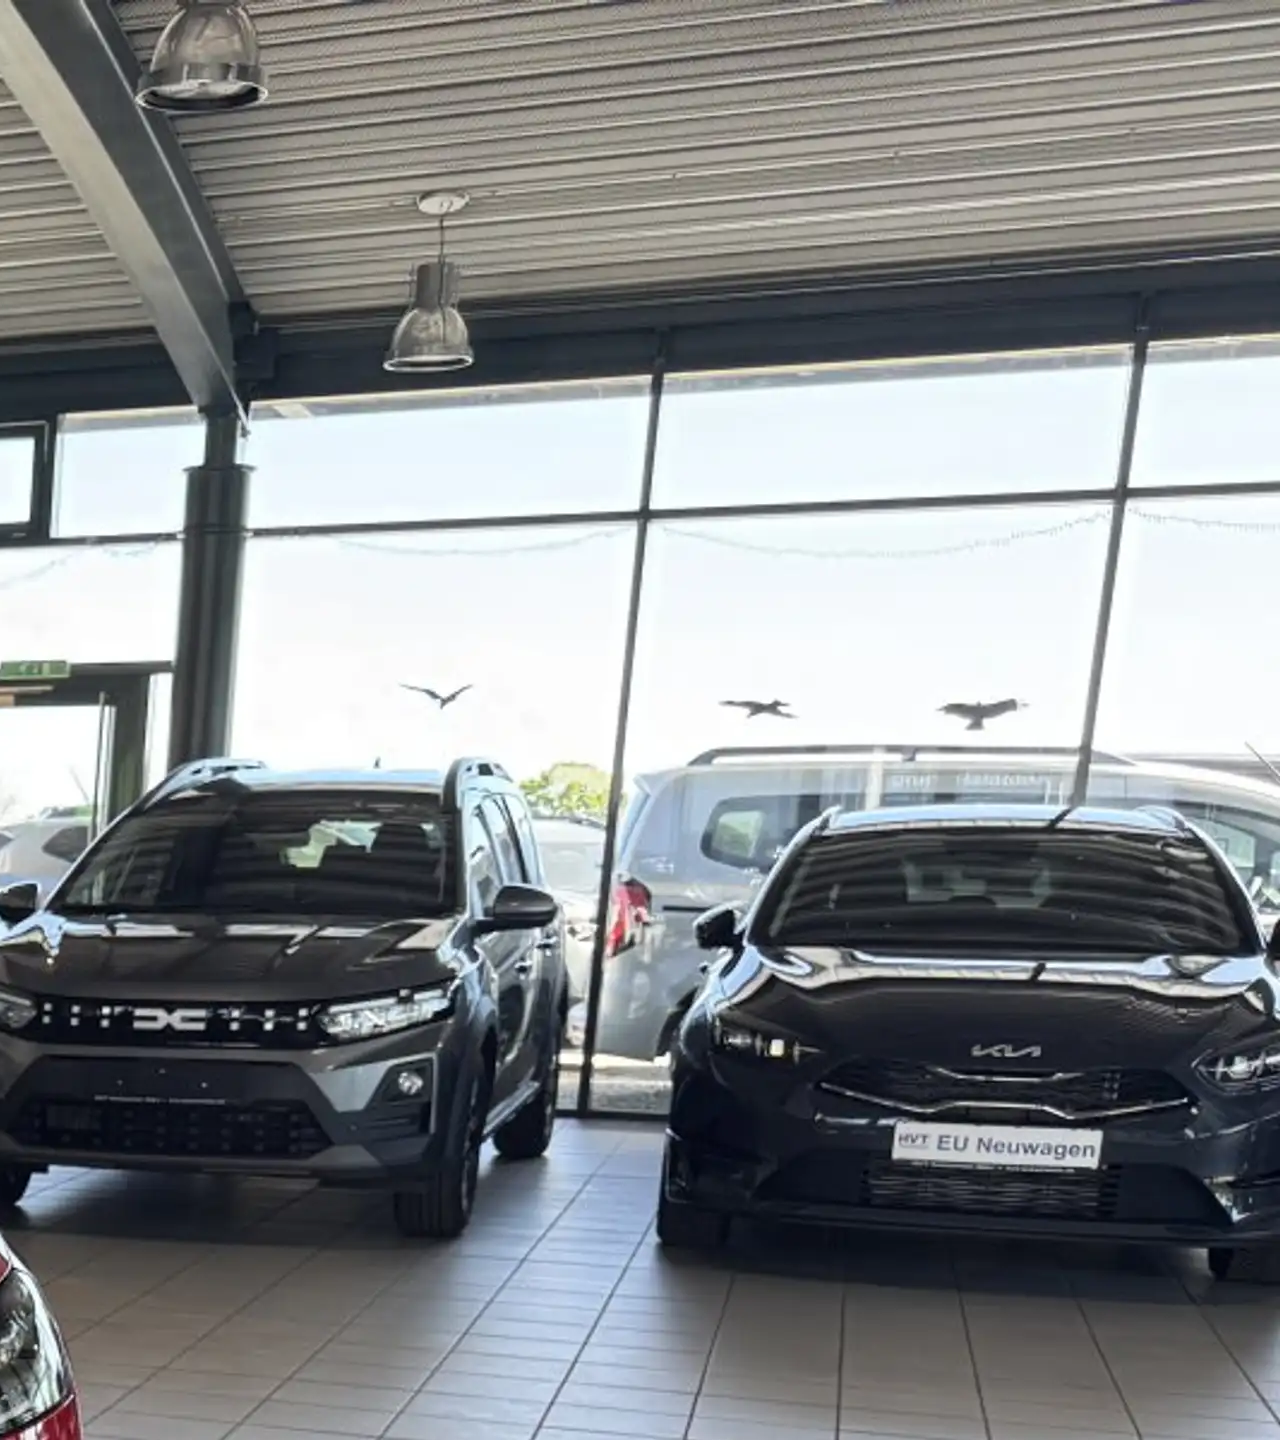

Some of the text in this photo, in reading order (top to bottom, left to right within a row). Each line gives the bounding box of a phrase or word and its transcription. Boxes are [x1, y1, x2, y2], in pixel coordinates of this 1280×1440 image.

[898, 1133, 1096, 1160] HVT EU Neuwagen
